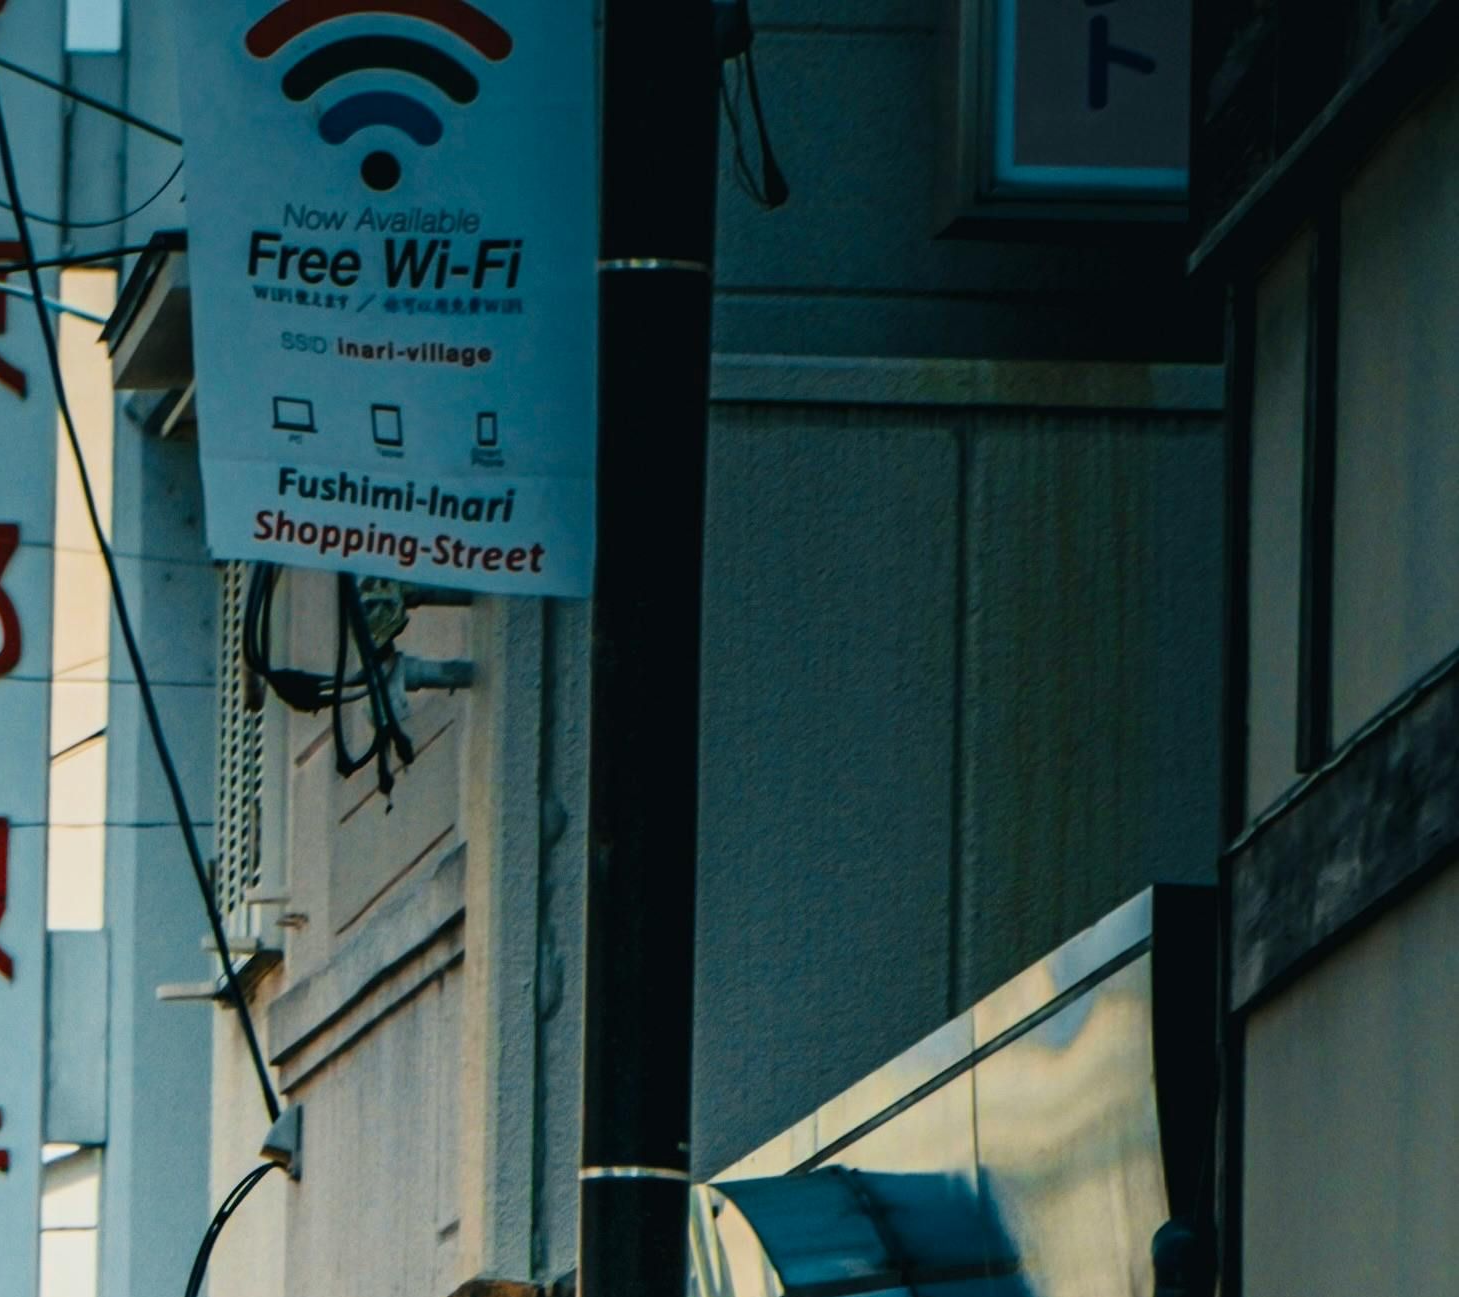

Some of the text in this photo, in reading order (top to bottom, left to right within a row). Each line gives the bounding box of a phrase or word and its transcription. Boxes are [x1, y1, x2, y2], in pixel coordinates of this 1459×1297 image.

[282, 202, 481, 234] Now Available
[248, 230, 524, 290] Free Wi-Fi
[280, 330, 327, 355] SSID
[278, 466, 516, 524] Fushimi-Inari
[253, 510, 546, 573] Shopping-Street
